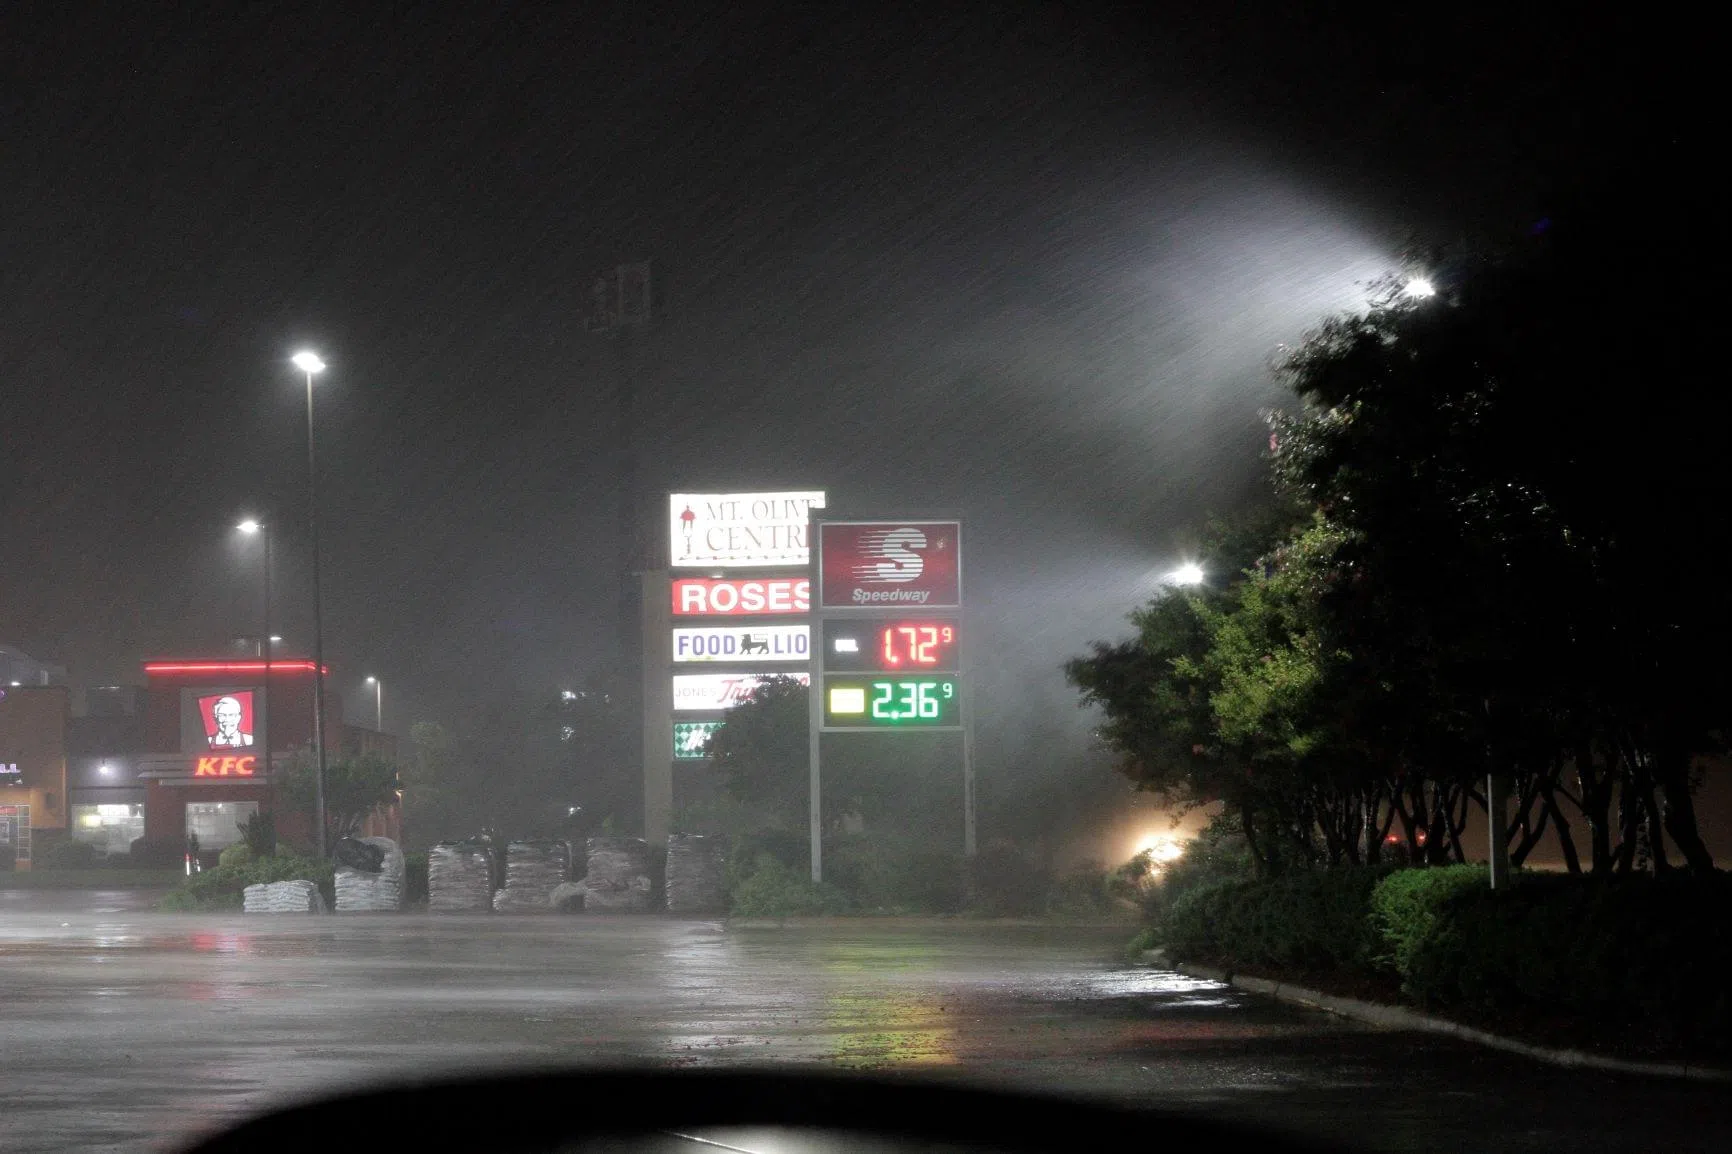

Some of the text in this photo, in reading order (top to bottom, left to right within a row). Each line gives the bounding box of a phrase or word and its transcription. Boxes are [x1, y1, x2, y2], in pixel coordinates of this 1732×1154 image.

[706, 501, 743, 521] MT.
[681, 581, 810, 613] ROSES
[852, 588, 931, 604] Speedway
[678, 633, 808, 656] FOOD LIO
[194, 756, 256, 776] KFC
